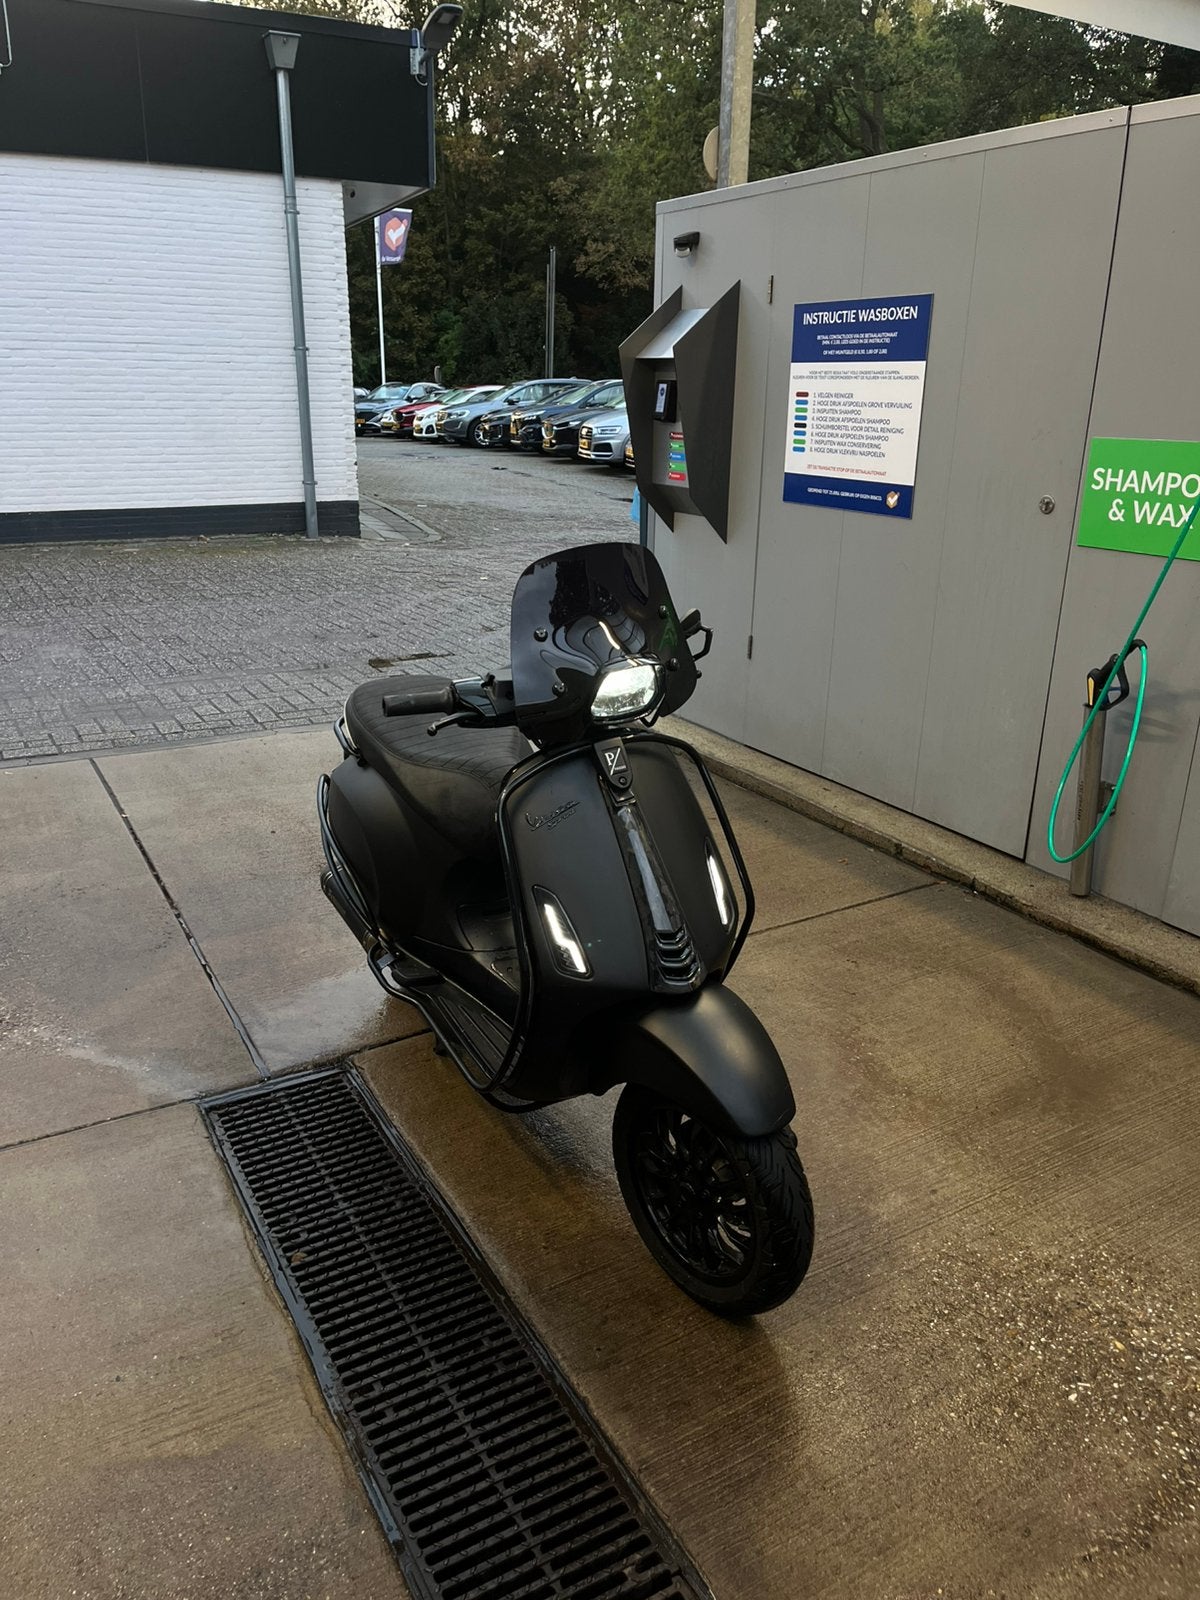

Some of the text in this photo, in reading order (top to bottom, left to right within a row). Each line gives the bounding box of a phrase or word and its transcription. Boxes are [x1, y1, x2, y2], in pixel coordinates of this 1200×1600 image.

[803, 306, 918, 325] INSTRUCTIE WASBOXEN
[1108, 498, 1194, 530] & WAX
